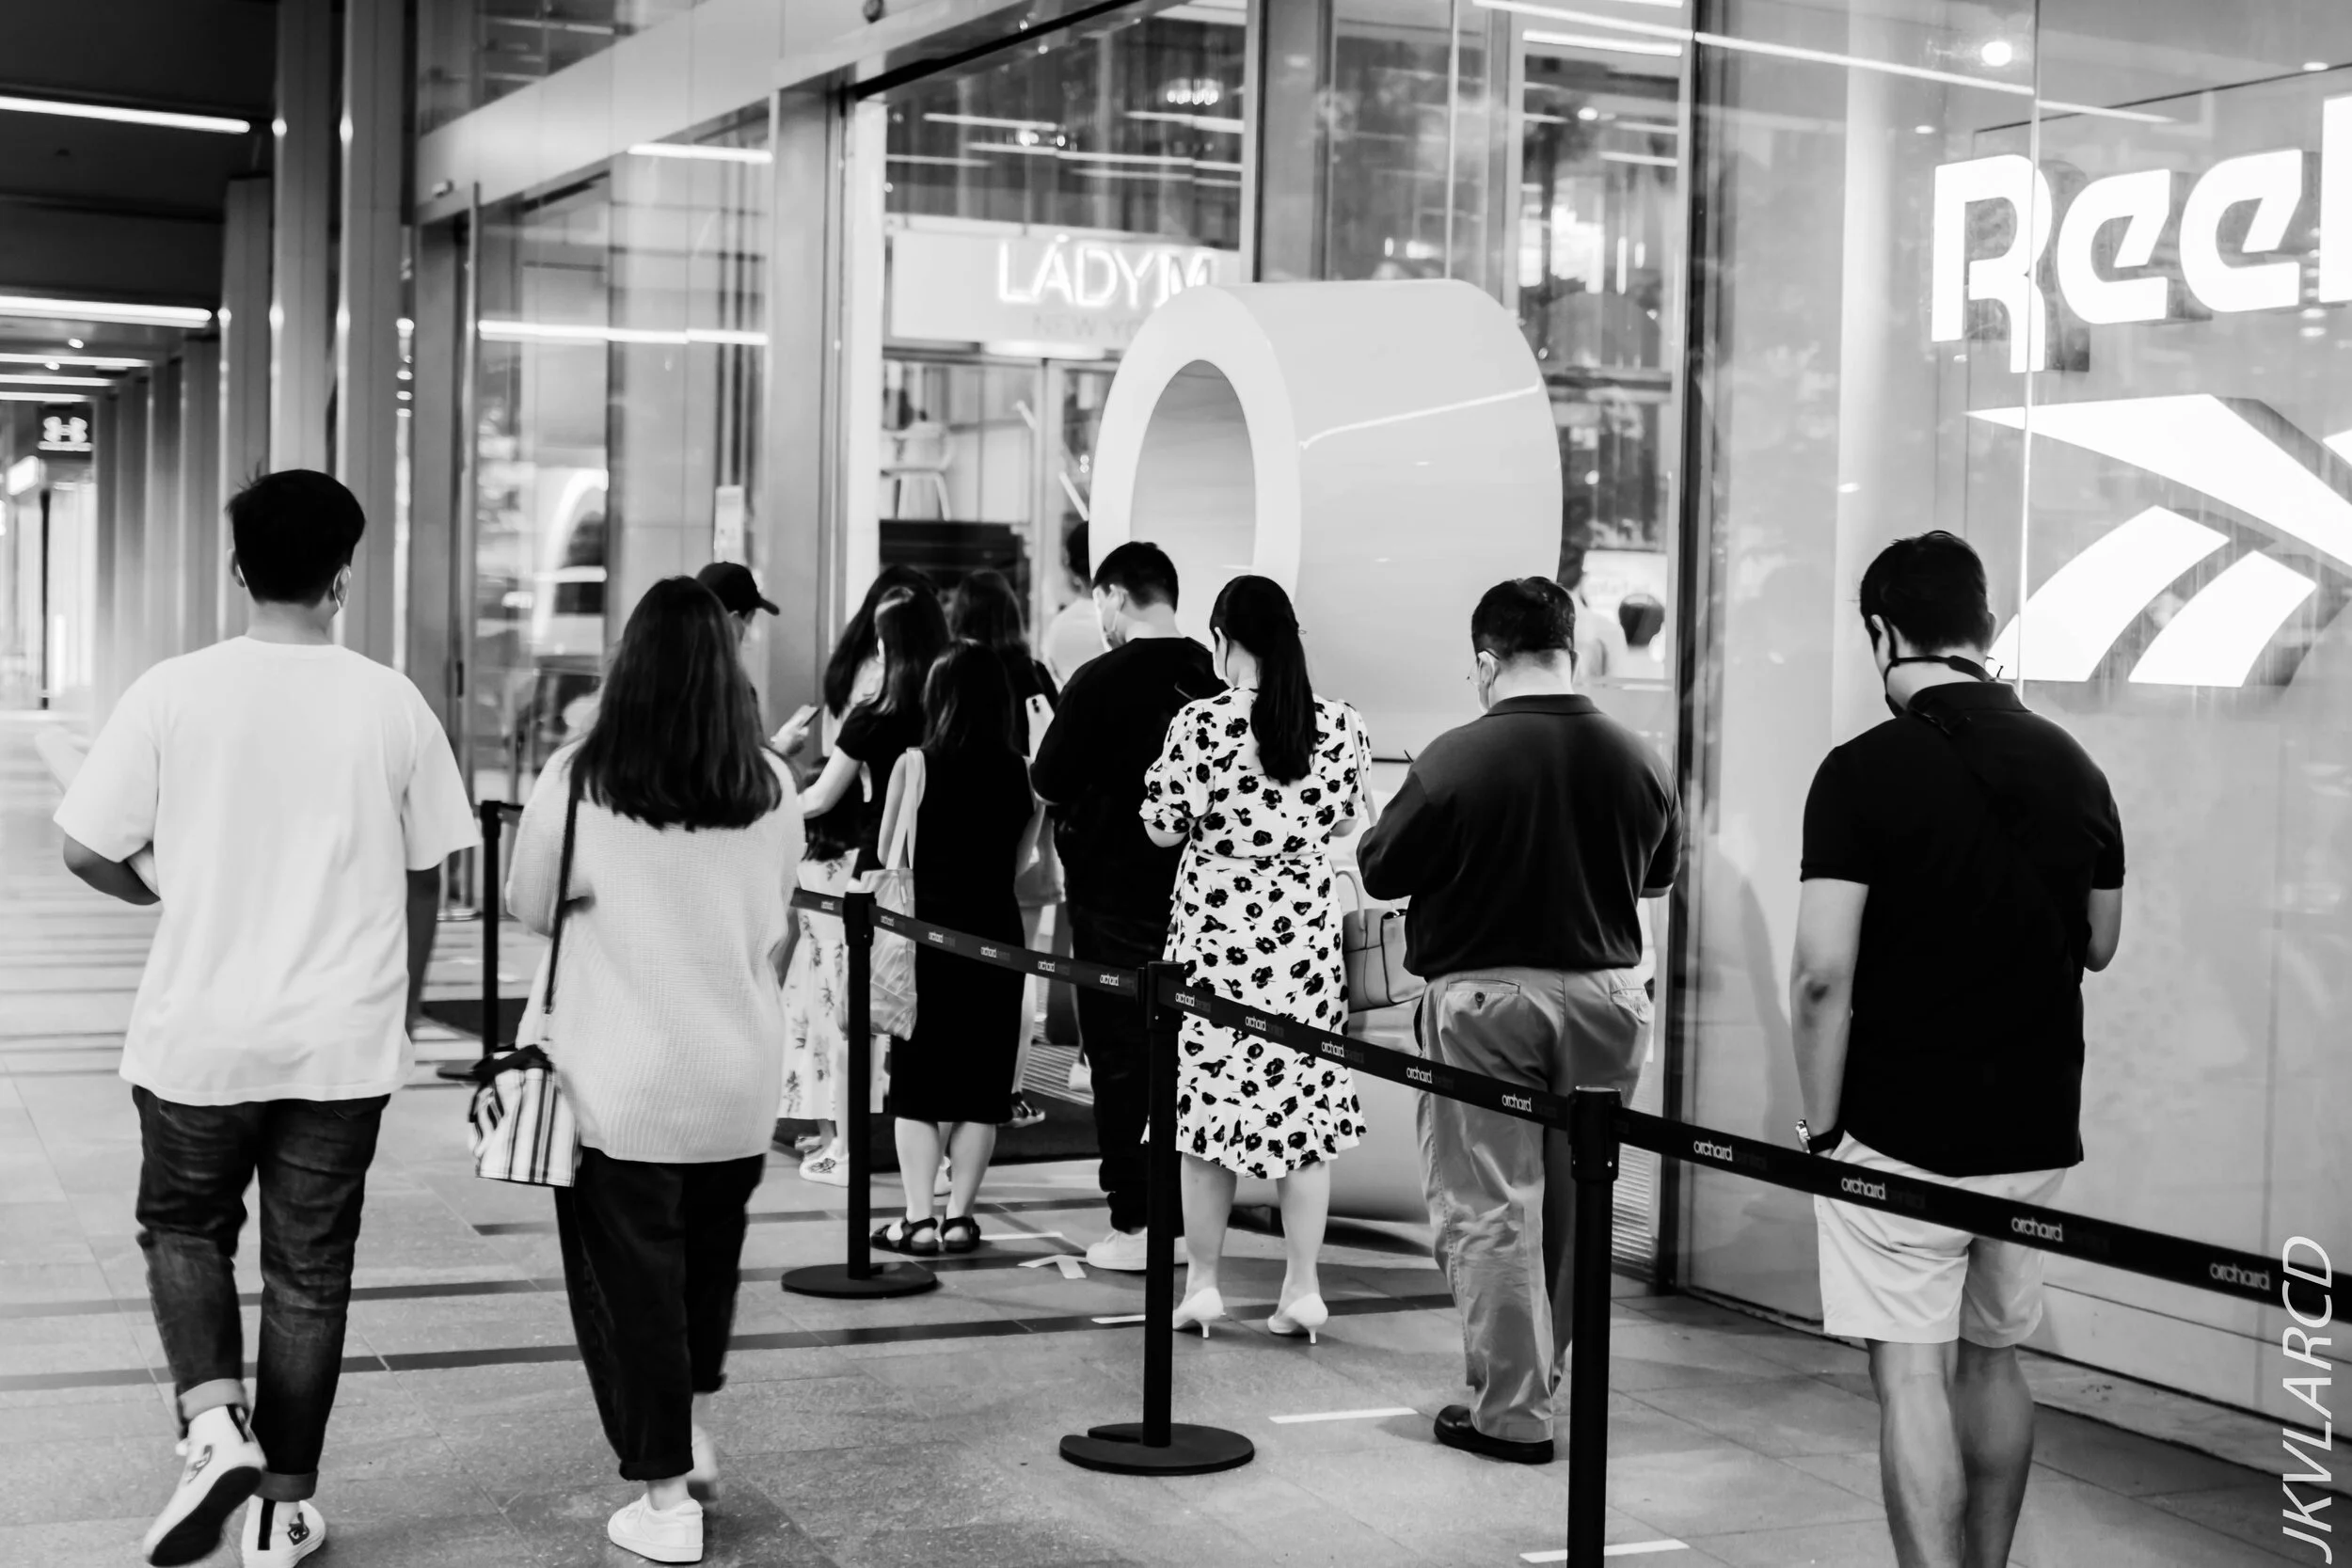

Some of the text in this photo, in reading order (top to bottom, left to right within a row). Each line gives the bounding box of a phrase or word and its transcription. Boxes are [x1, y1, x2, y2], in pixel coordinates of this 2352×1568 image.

[1245, 1015, 1267, 1032] orchard
[1321, 1040, 1345, 1058] orchard
[1406, 1066, 1433, 1085] orchard
[1502, 1093, 1534, 1115] orchard
[1692, 1139, 1733, 1162] orchard
[1841, 1177, 1886, 1200] orchard
[2010, 1216, 2064, 1243] orchard
[2210, 1261, 2271, 1291] orchard
